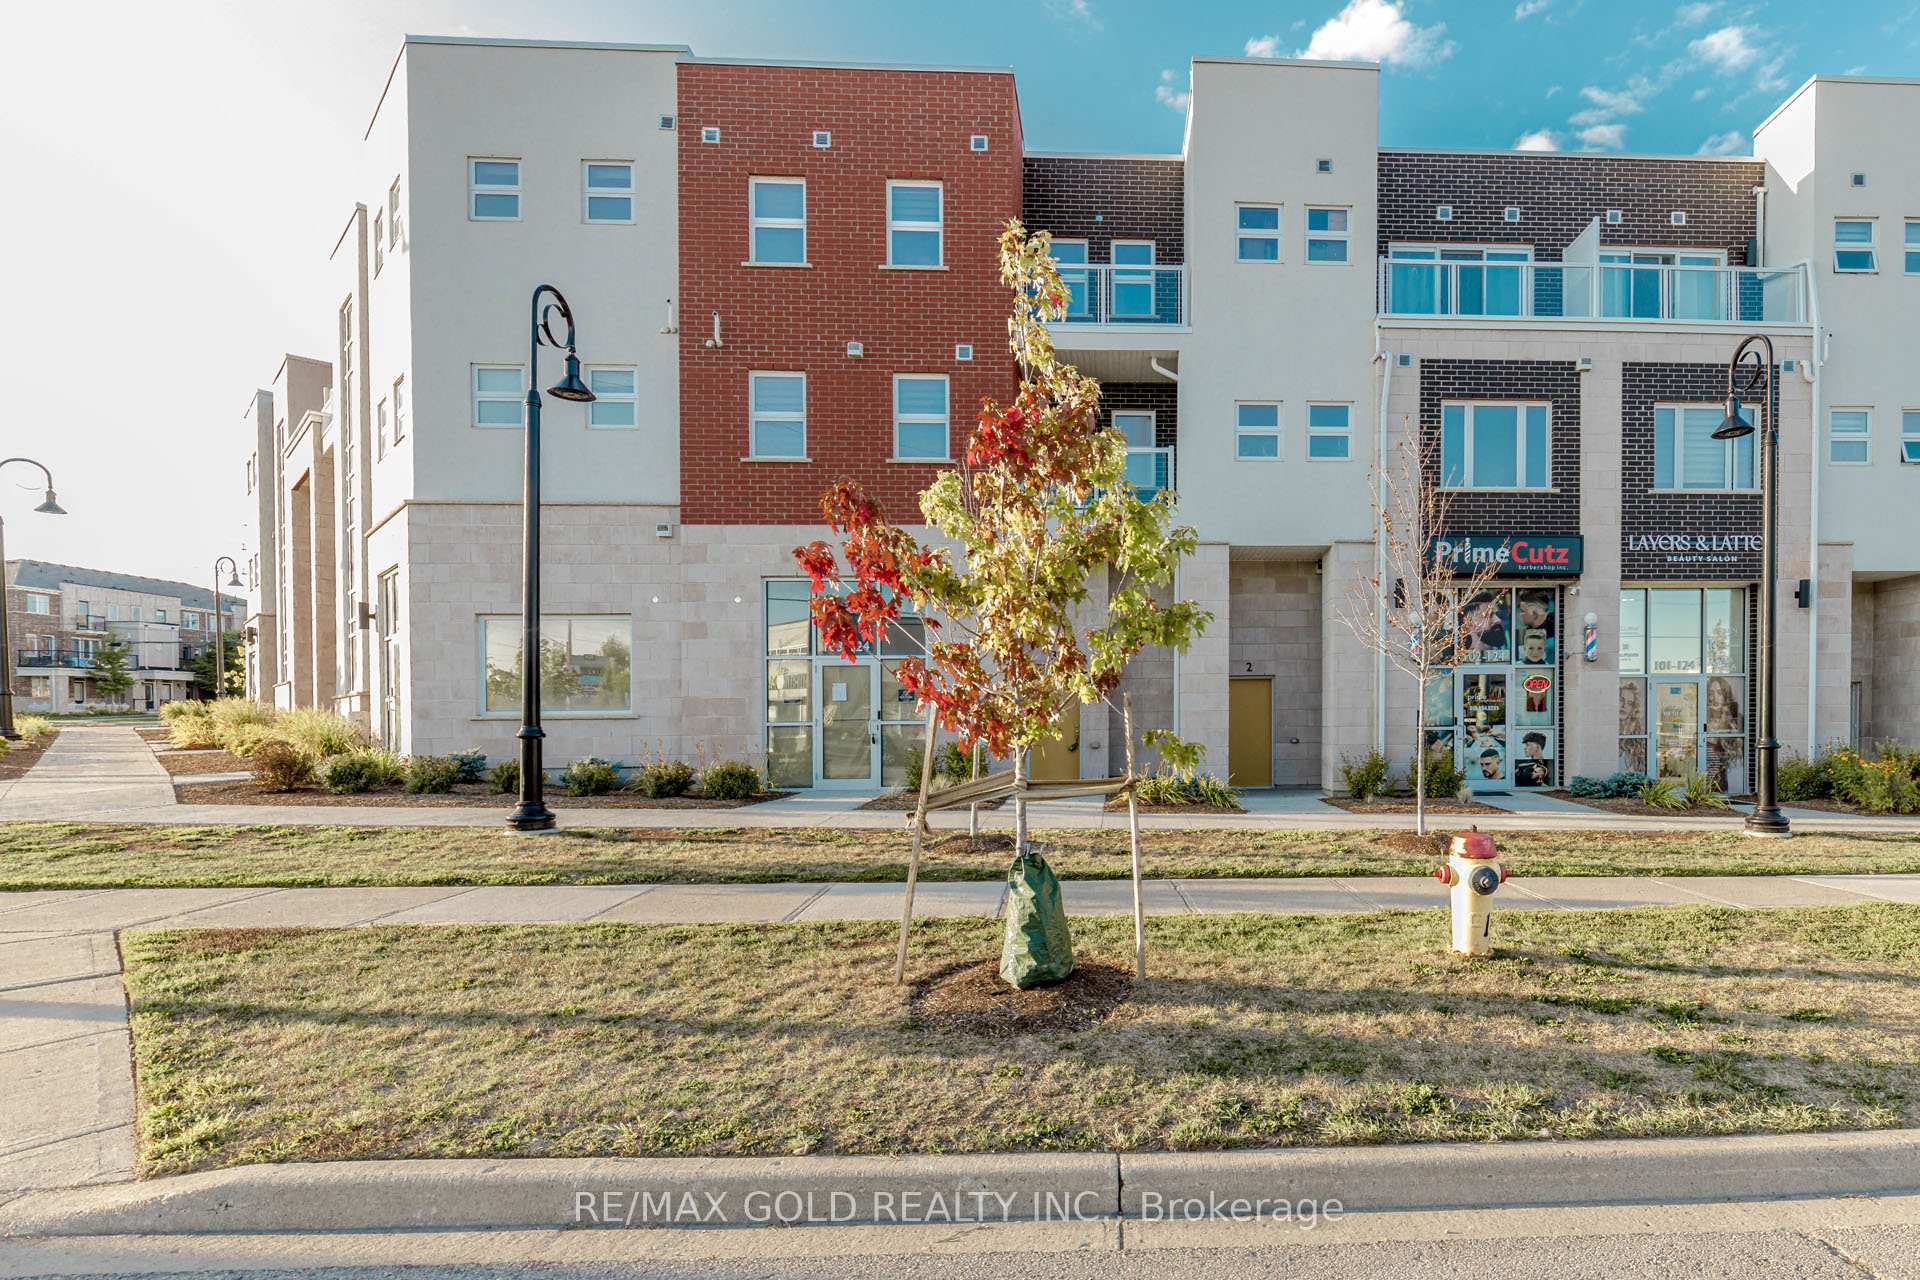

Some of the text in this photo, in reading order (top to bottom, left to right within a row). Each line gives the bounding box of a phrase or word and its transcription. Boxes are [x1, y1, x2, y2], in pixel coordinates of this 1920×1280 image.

[1629, 534, 1764, 551] LAYERS & LATTE
[1246, 662, 1253, 672] 2
[1654, 660, 1695, 671] 101-124
[1527, 679, 1549, 689] OPEN
